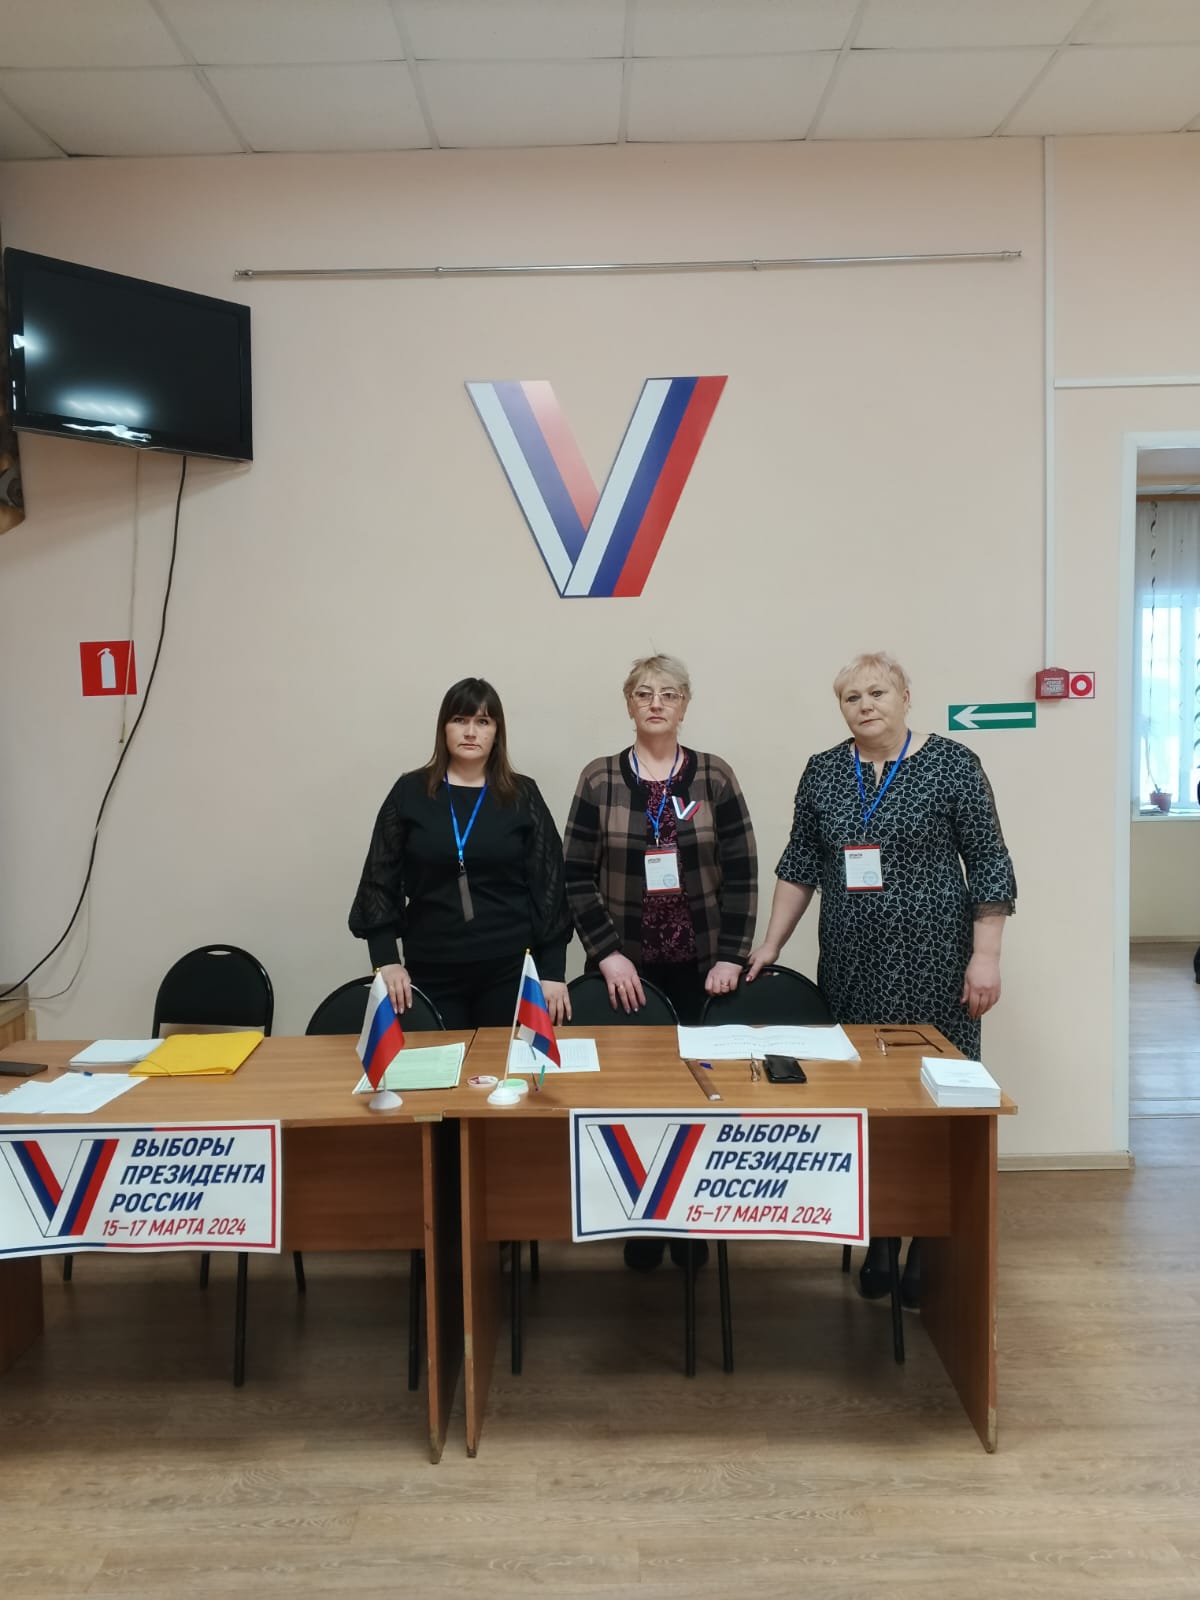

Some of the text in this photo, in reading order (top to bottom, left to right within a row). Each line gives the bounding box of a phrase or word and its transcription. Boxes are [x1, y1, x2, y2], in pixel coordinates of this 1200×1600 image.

[717, 1123, 821, 1144] ВЫБОРЫ
[131, 1137, 235, 1157] ВЫБОРЫ
[705, 1151, 852, 1174] ПРЕЗИДЕНТА
[120, 1164, 266, 1187] ПРЕЗИДЕНТА
[694, 1178, 789, 1199] РОССИИ
[109, 1191, 204, 1213] РОССИИ
[732, 1205, 789, 1224] МАРТА
[791, 1206, 832, 1225] 2024
[148, 1218, 204, 1237] МАРТА
[207, 1217, 247, 1236] 2024
